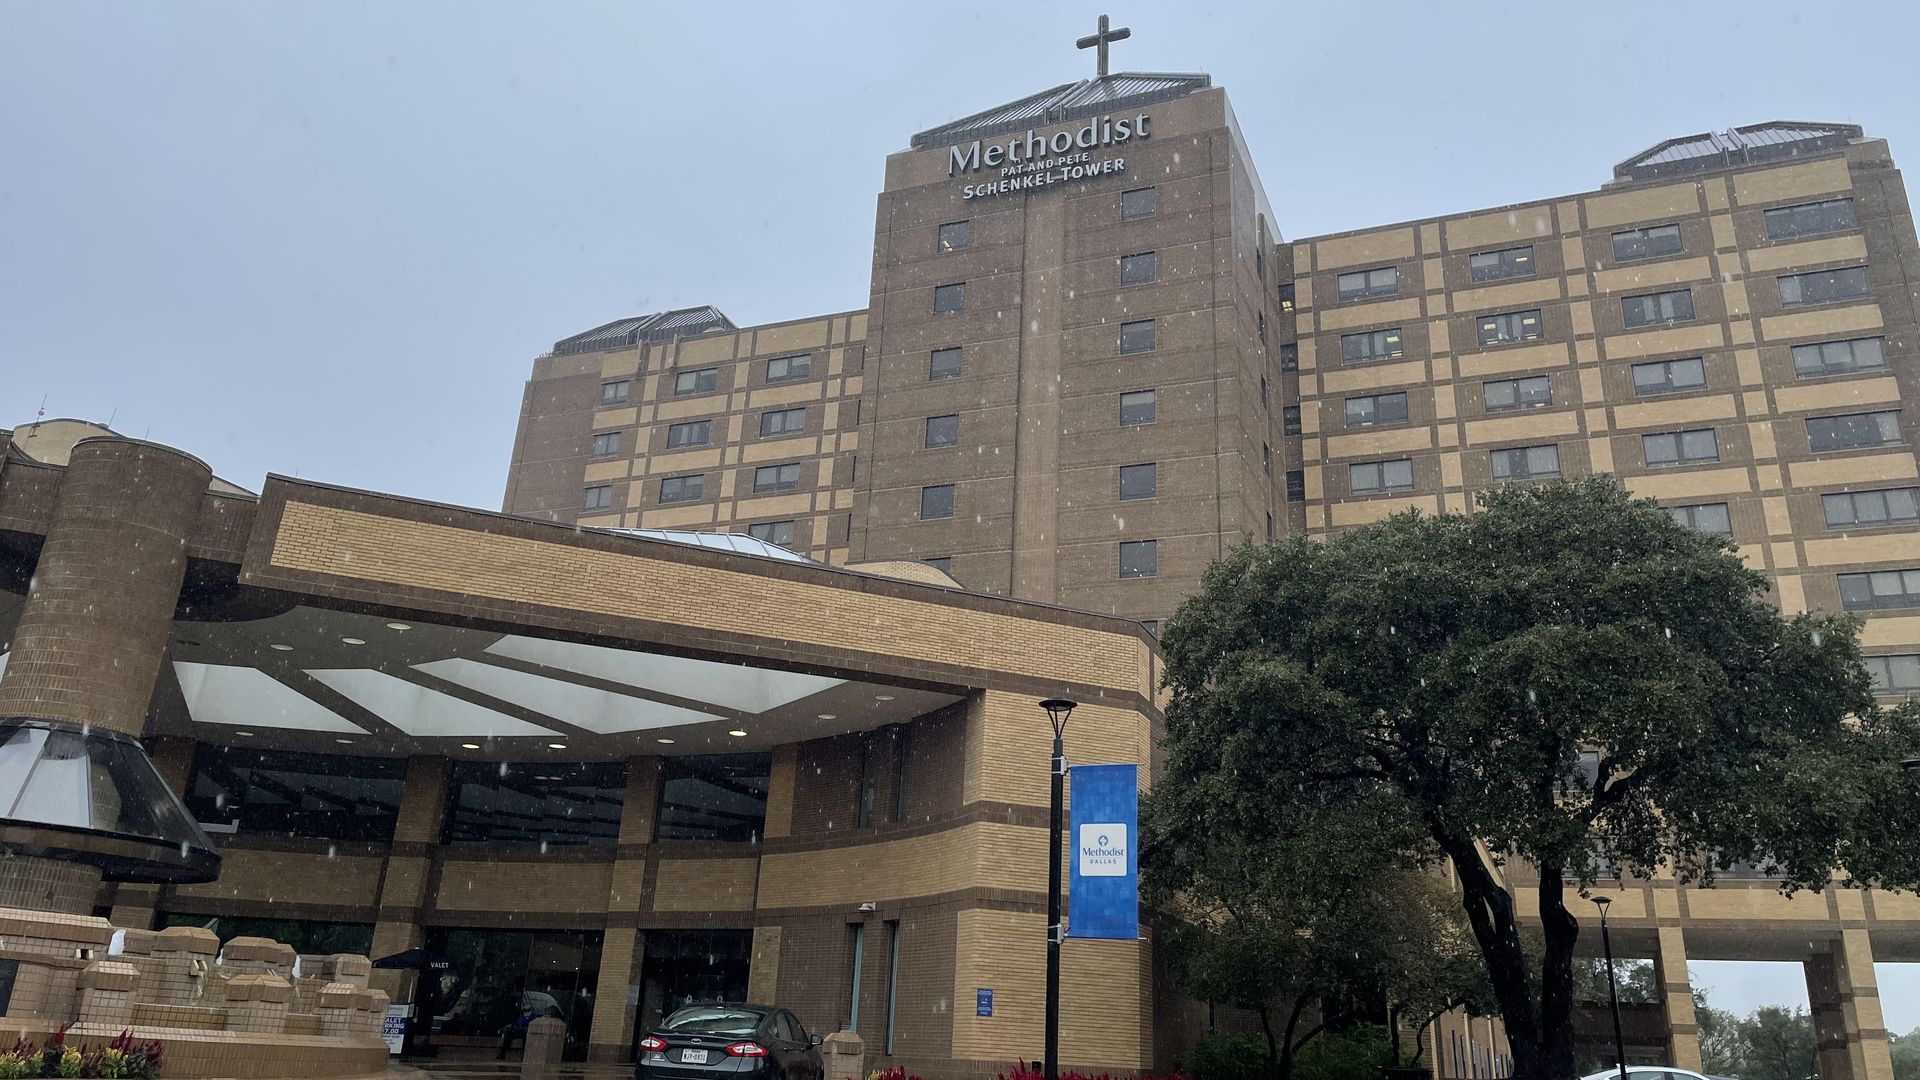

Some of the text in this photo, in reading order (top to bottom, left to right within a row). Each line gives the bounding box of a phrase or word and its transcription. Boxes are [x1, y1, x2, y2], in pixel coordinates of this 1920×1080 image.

[948, 112, 1150, 175] Methodist
[1001, 152, 1090, 177] PAT AND PETE
[962, 158, 1125, 199] SCHENKEL TOWER
[1082, 847, 1125, 857] Methodist
[430, 961, 449, 969] VALET
